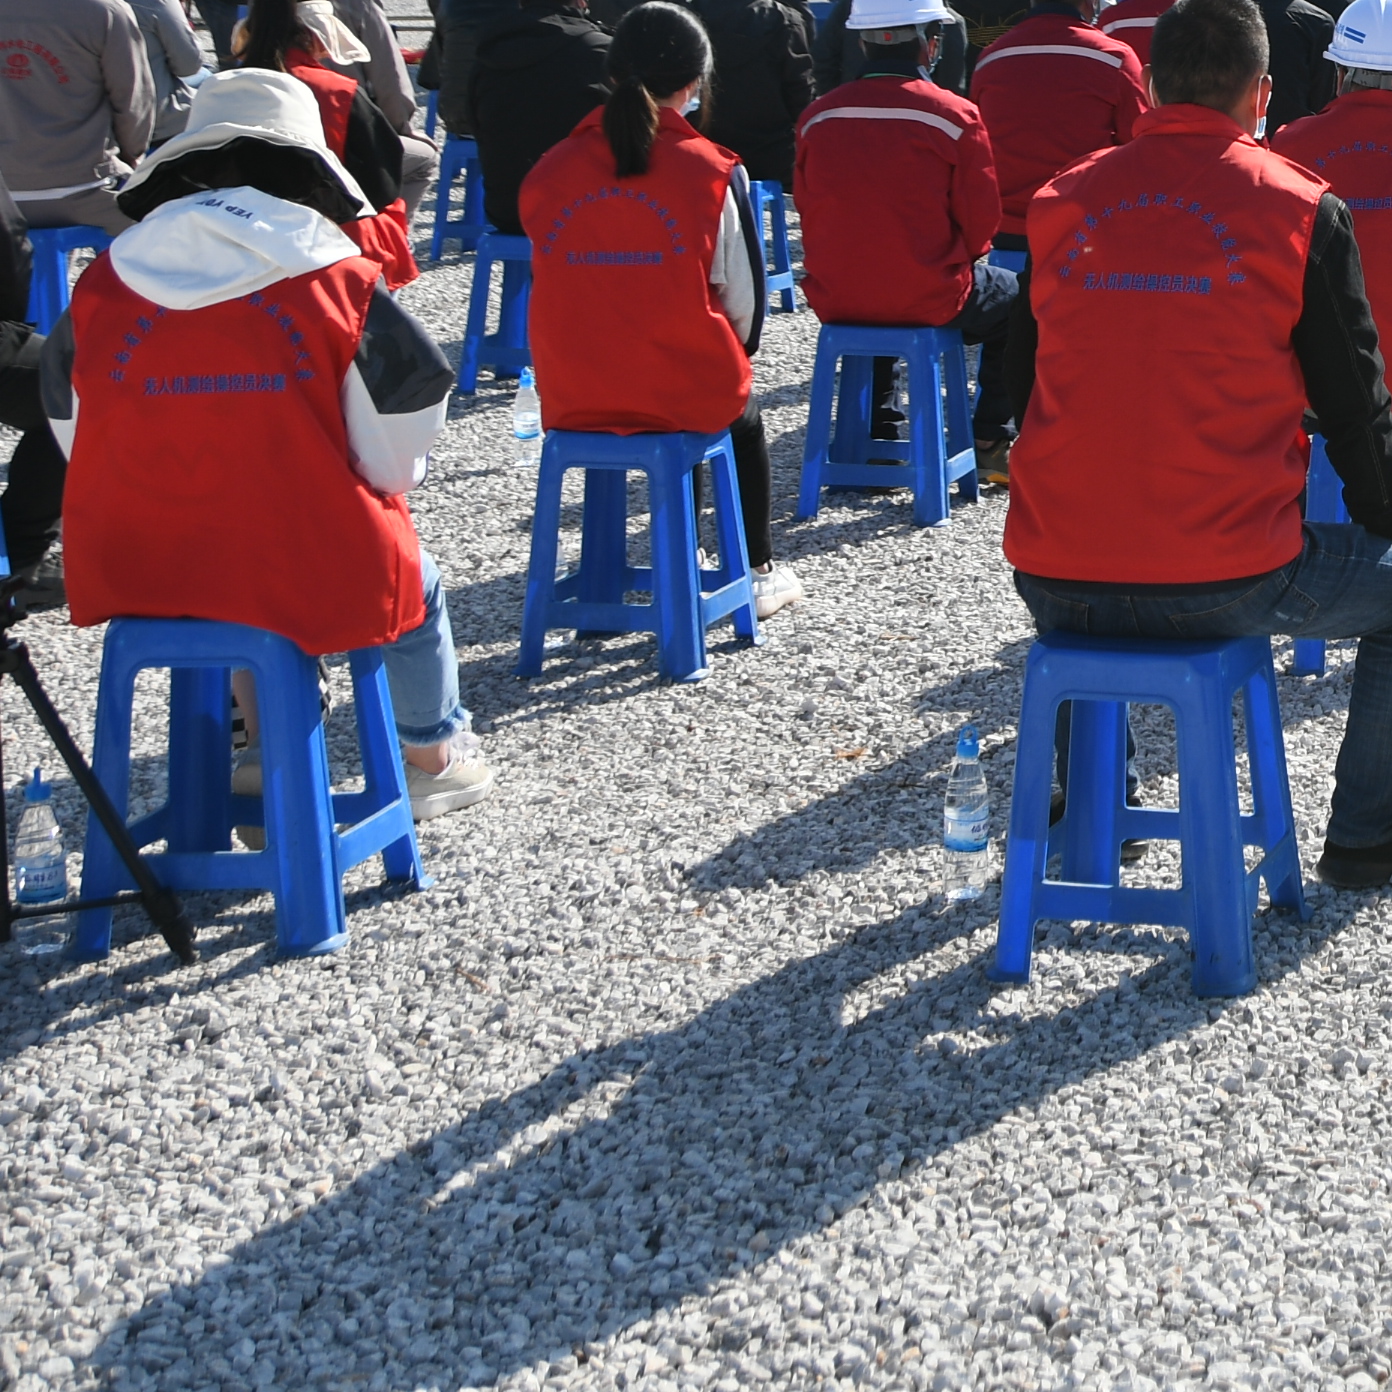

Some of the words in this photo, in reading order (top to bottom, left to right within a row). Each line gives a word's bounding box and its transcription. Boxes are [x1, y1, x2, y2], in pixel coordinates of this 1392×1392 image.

[1083, 272, 1213, 295] 无人机测绘操控员决赛
[144, 372, 287, 396] 无人机测绘操控员决赛
